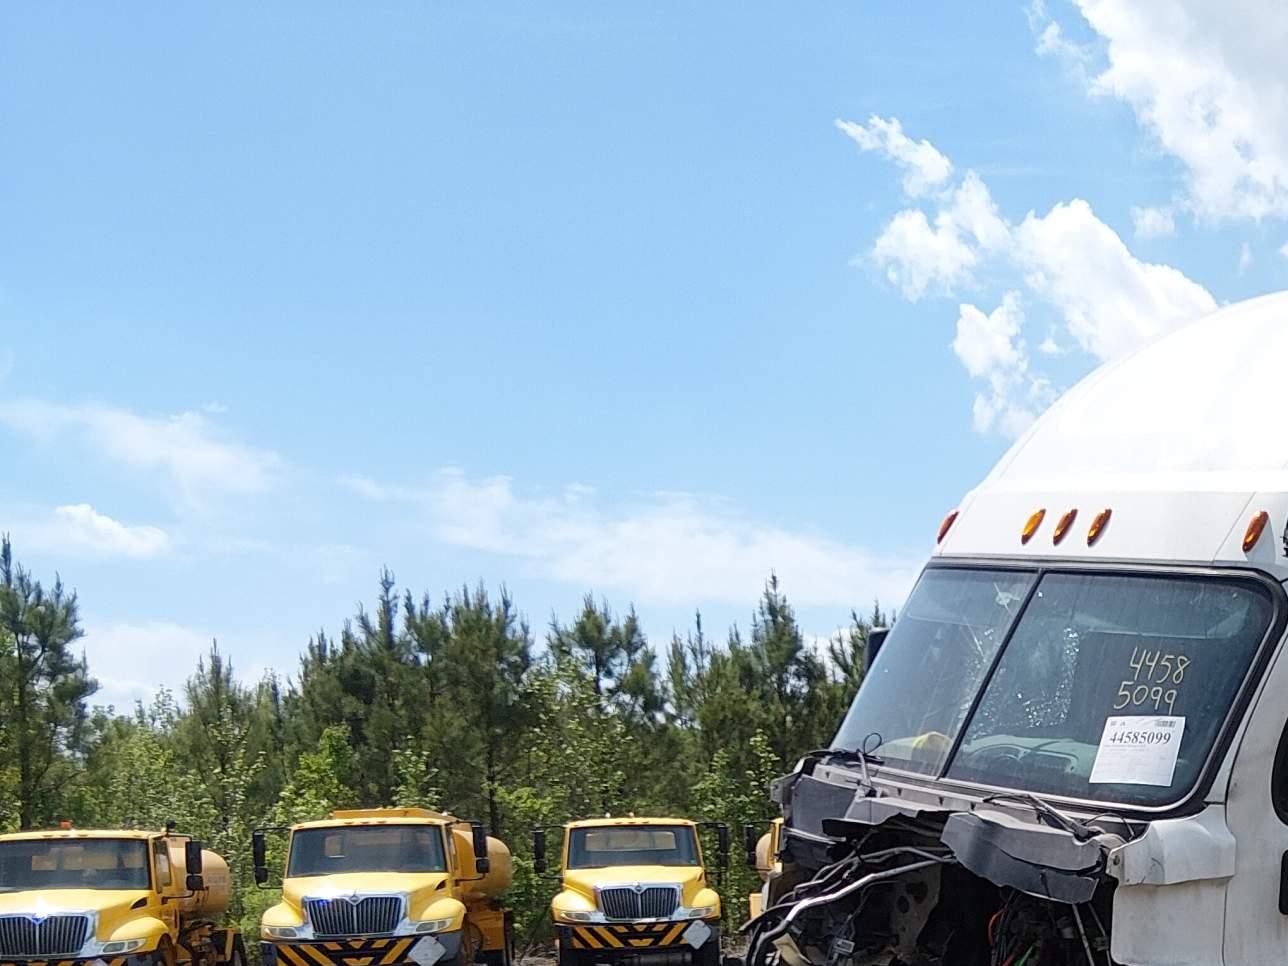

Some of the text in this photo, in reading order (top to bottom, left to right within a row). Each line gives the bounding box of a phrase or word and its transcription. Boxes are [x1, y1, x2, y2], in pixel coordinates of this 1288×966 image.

[1130, 646, 1190, 684] 4458
[1113, 681, 1177, 716] 5099
[1109, 731, 1171, 745] 44585099
